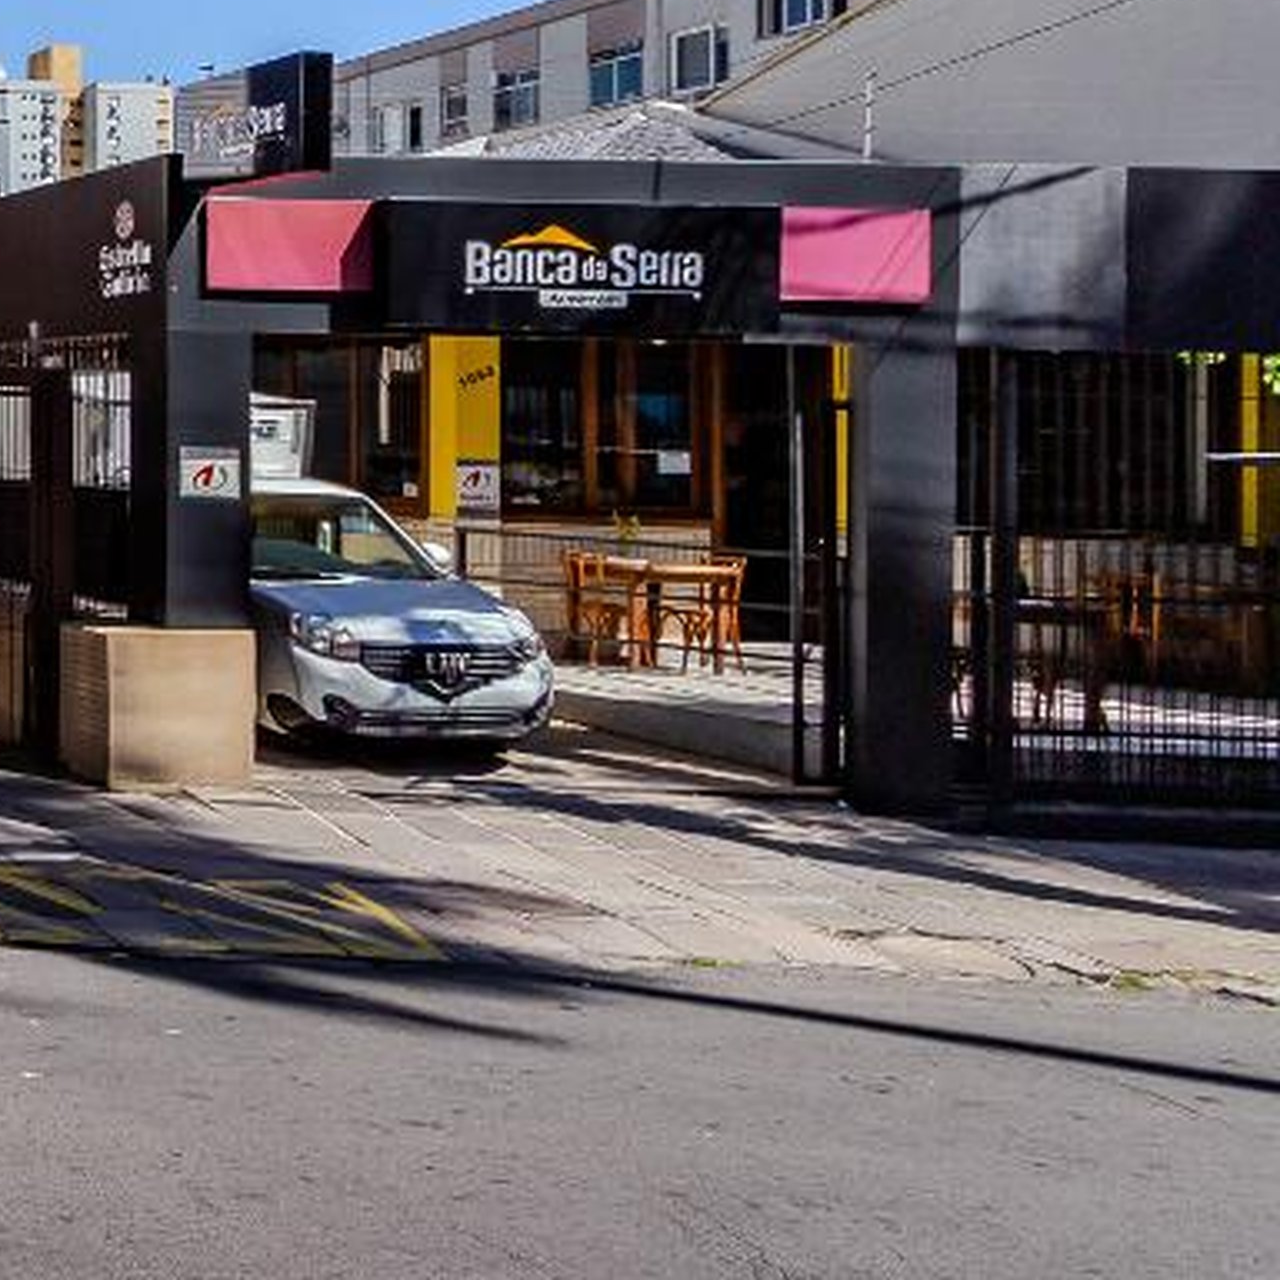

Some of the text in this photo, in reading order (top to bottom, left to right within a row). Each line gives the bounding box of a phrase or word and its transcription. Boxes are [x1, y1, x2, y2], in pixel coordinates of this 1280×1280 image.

[465, 240, 704, 288] Banca da Serra
